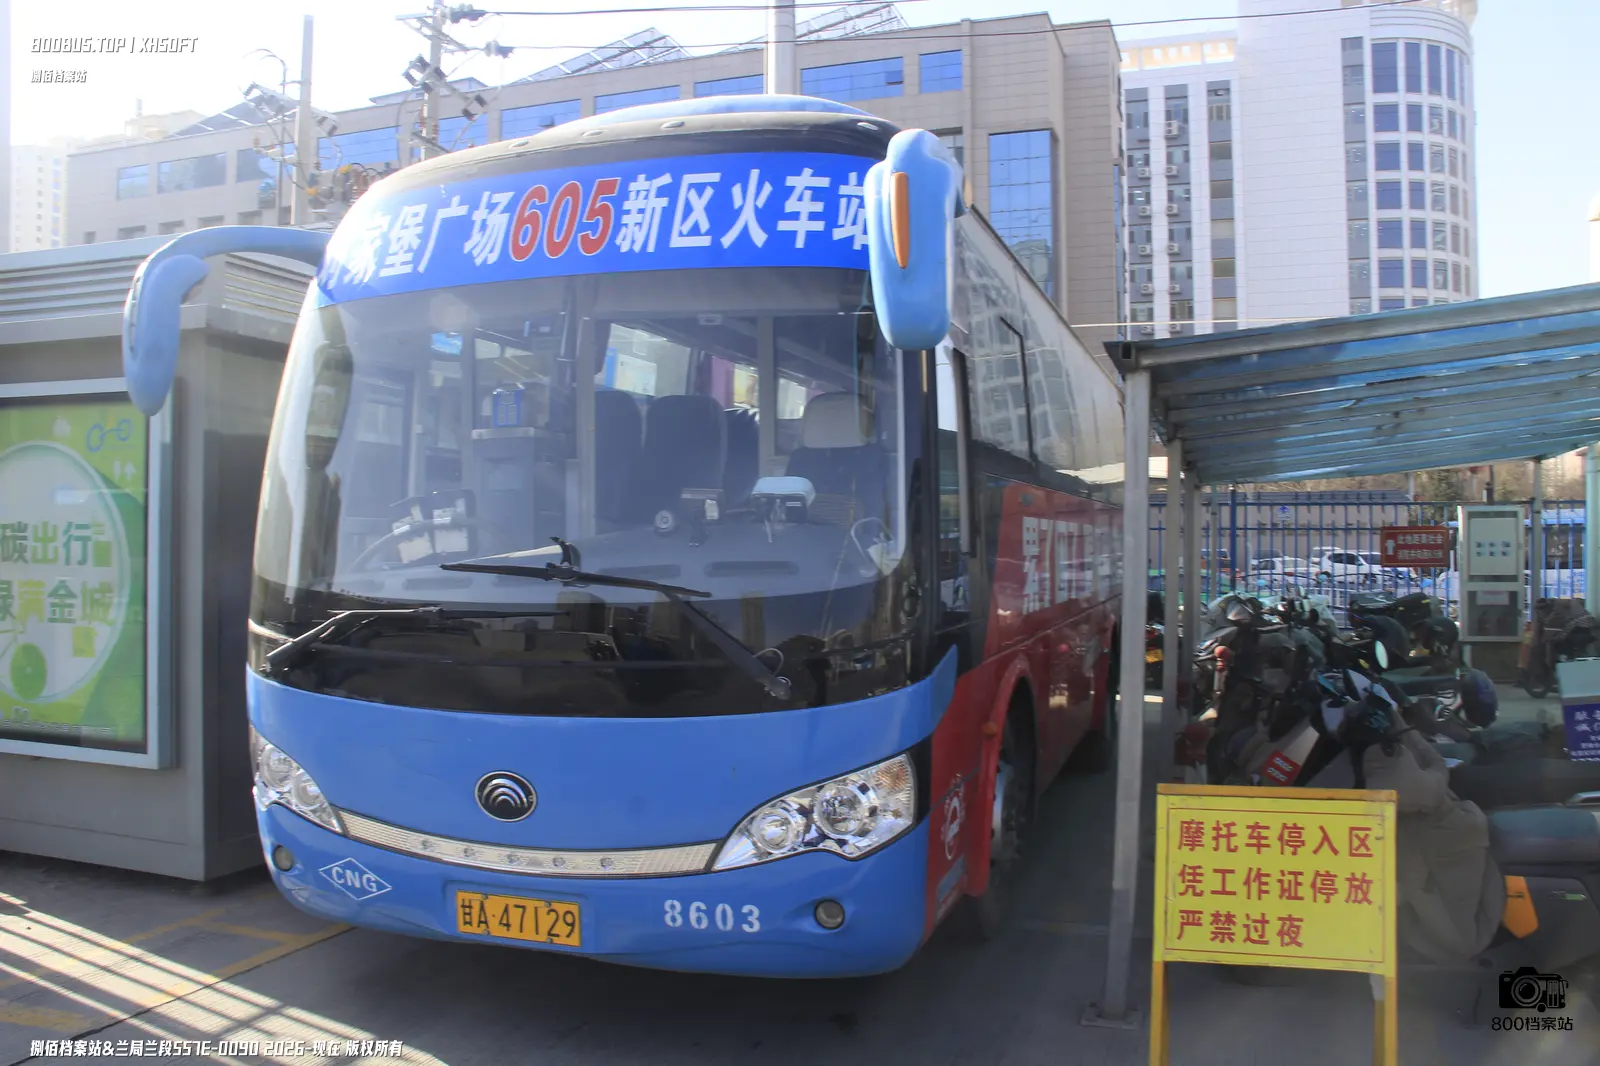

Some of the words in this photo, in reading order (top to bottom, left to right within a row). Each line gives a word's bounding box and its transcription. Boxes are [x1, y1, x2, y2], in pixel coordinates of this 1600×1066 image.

[508, 177, 622, 262] 605
[614, 167, 869, 254] 新区火车站
[1177, 819, 1374, 858] 摩托车停入区
[331, 866, 377, 892] CNG
[1177, 863, 1374, 905] 凭工作证停放
[664, 899, 761, 933] 8603
[1177, 908, 1304, 948] 严禁过夜
